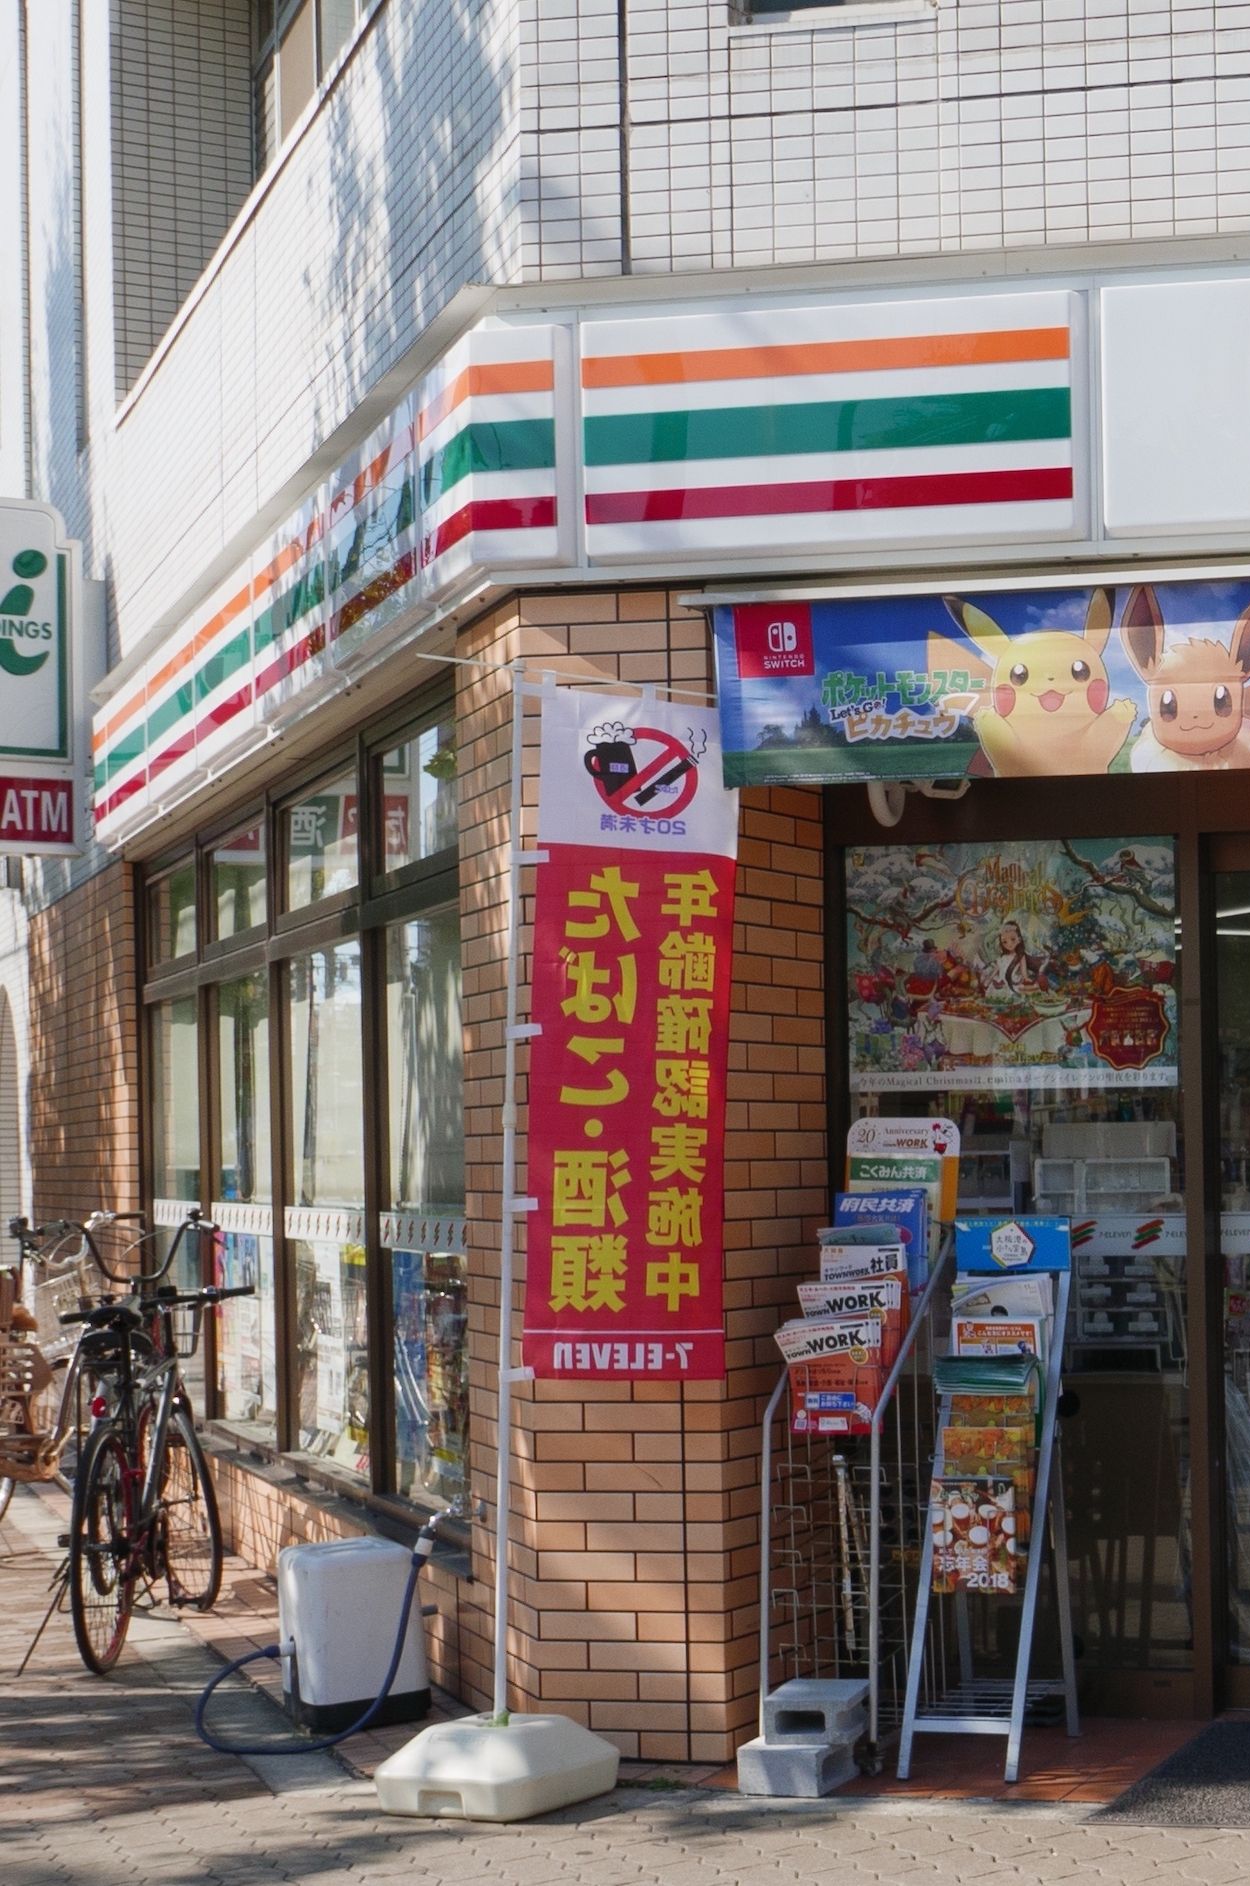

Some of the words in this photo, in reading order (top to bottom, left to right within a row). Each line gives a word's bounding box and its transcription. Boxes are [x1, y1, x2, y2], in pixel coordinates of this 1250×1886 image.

[763, 659, 806, 669] SWITCH
[821, 669, 986, 707] ポケットモンスター
[830, 701, 861, 721] Let's
[844, 708, 962, 739] ピカチュウ
[1, 789, 68, 832] ATM
[883, 1127, 929, 1138] Anniversary
[859, 1164, 928, 1180] こくみん共済
[839, 1197, 915, 1213] 府民共済
[871, 1254, 898, 1274] 社員
[826, 1291, 886, 1313] WORK
[807, 1330, 866, 1353] WORK
[939, 1556, 988, 1572] 忘年会
[967, 1572, 1009, 1588] 2018
